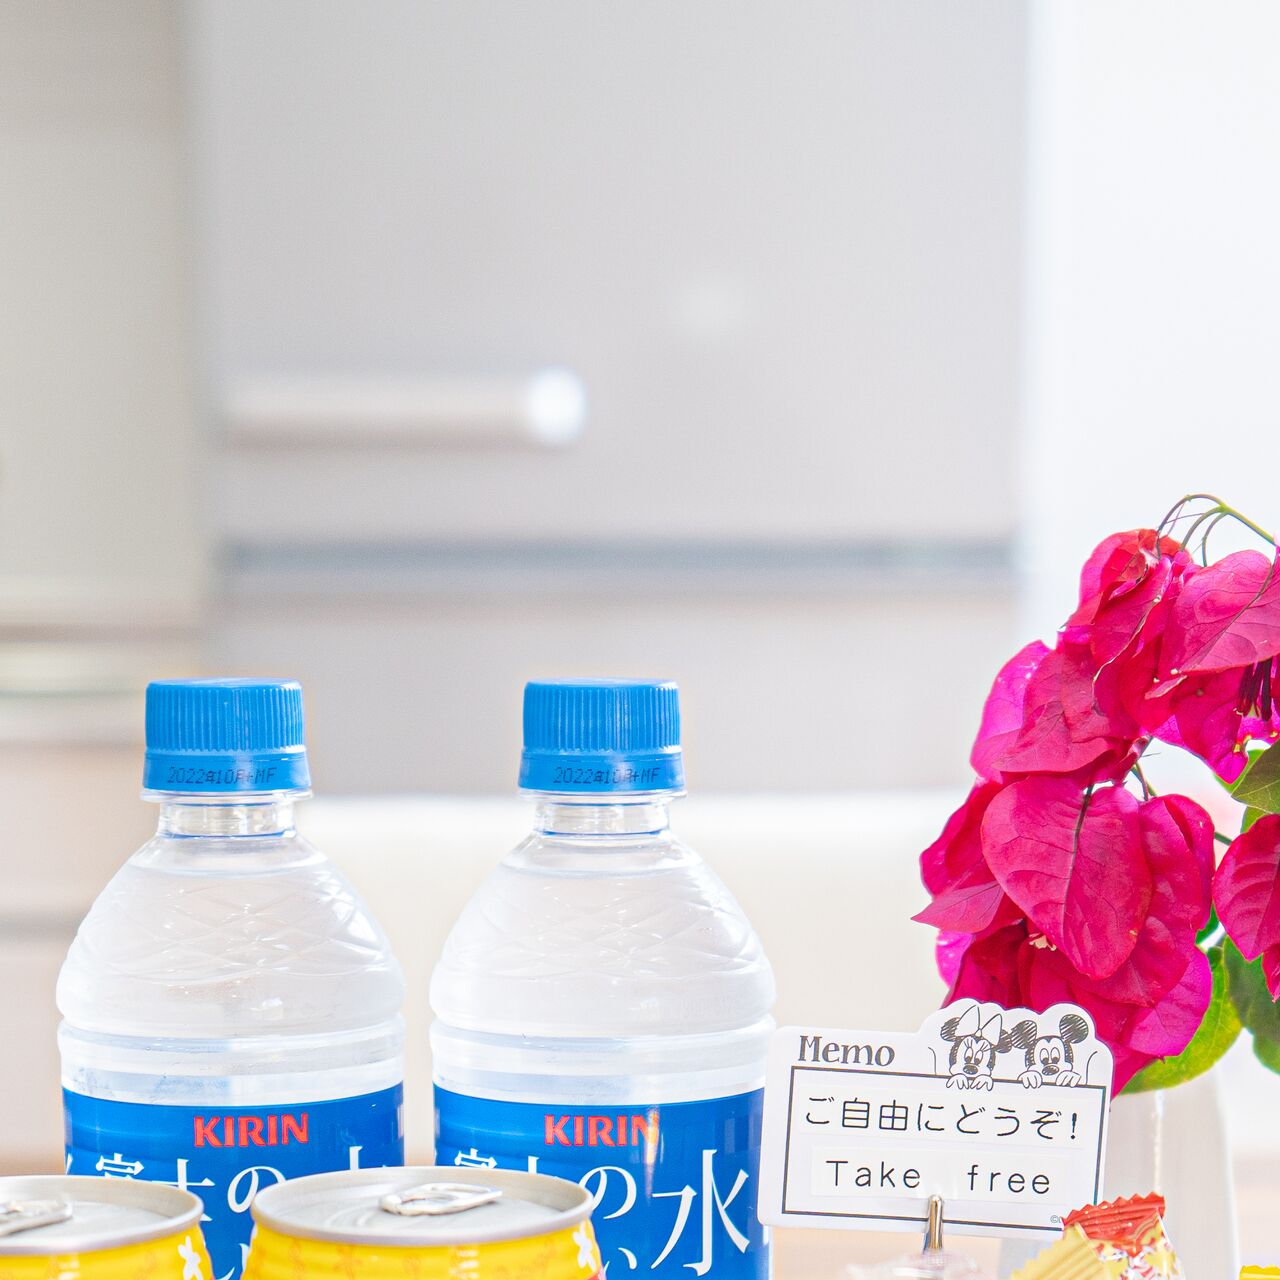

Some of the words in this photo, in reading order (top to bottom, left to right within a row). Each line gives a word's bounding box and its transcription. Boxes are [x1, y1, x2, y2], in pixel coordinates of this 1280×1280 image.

[798, 1034, 896, 1067] Memo
[194, 1112, 309, 1148] KIRIN
[544, 1114, 659, 1147] KIRIN
[825, 1159, 921, 1189] Take
[966, 1164, 1051, 1195] free
